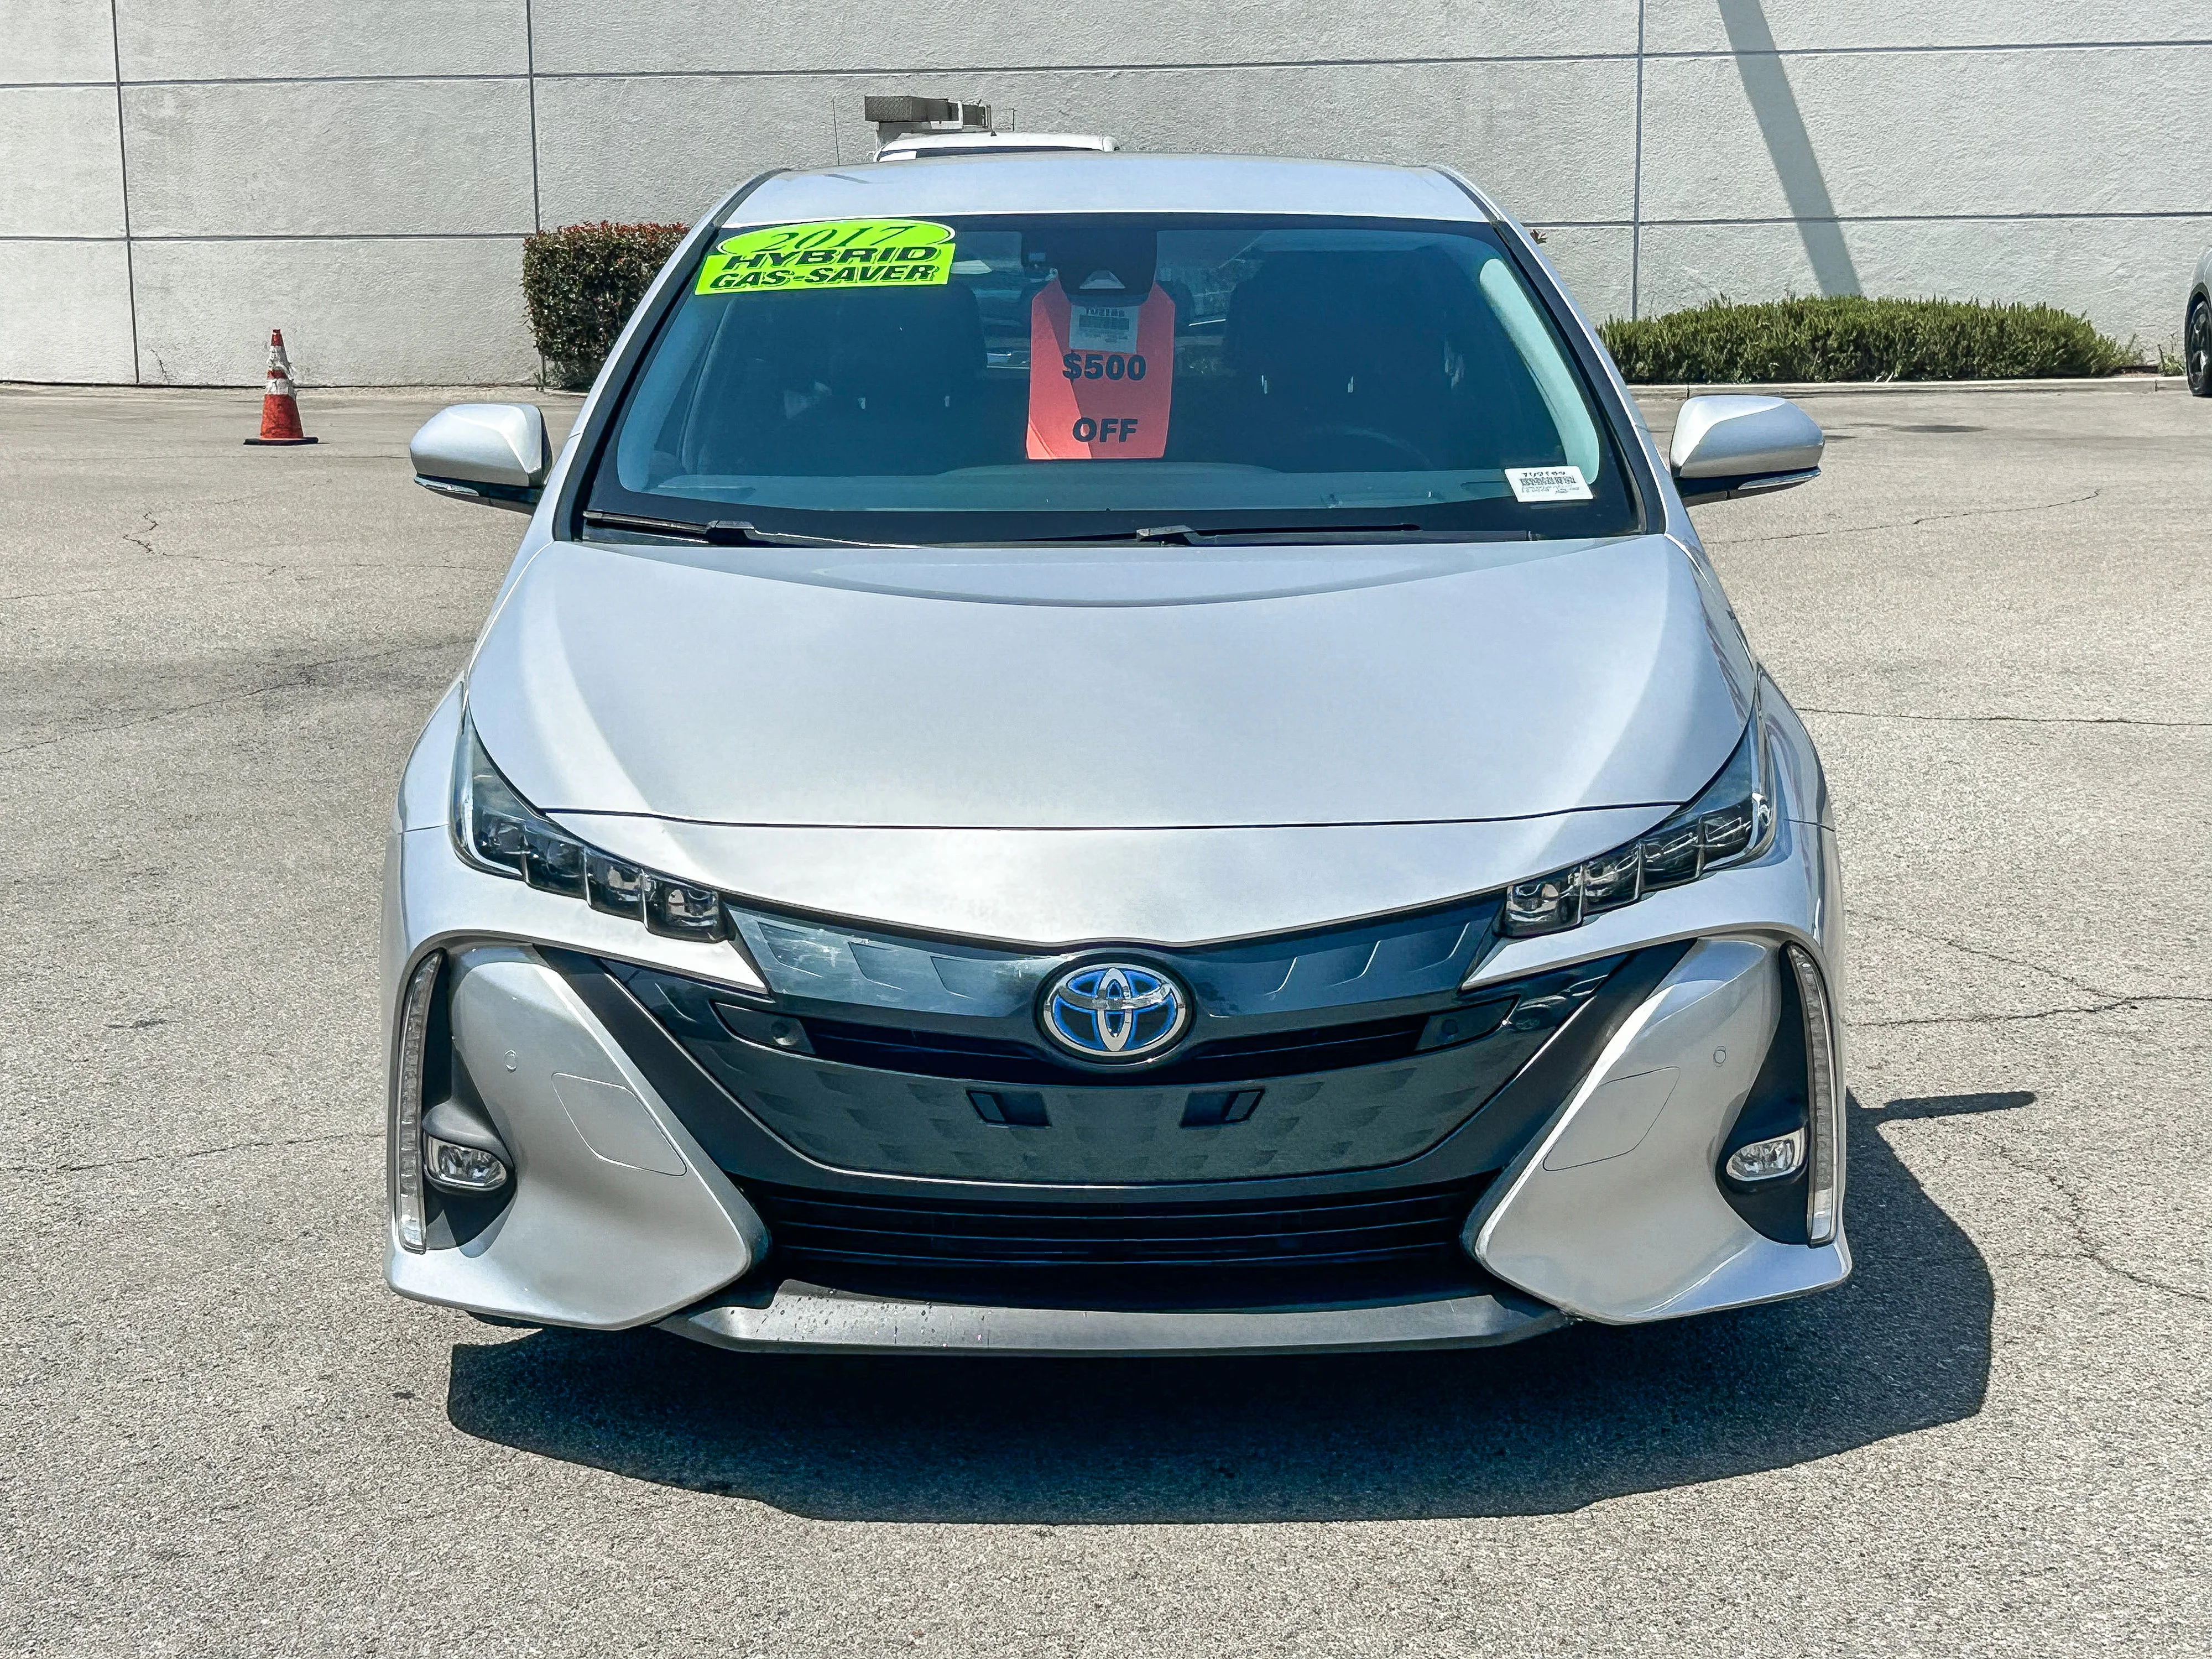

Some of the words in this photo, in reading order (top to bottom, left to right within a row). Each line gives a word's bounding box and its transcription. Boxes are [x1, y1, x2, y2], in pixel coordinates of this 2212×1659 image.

[756, 226, 916, 252] 2017
[722, 246, 941, 270] HYBRID
[710, 264, 939, 289] GAS-SAVER
[1062, 352, 1146, 383] $500
[1072, 418, 1138, 443] OFF
